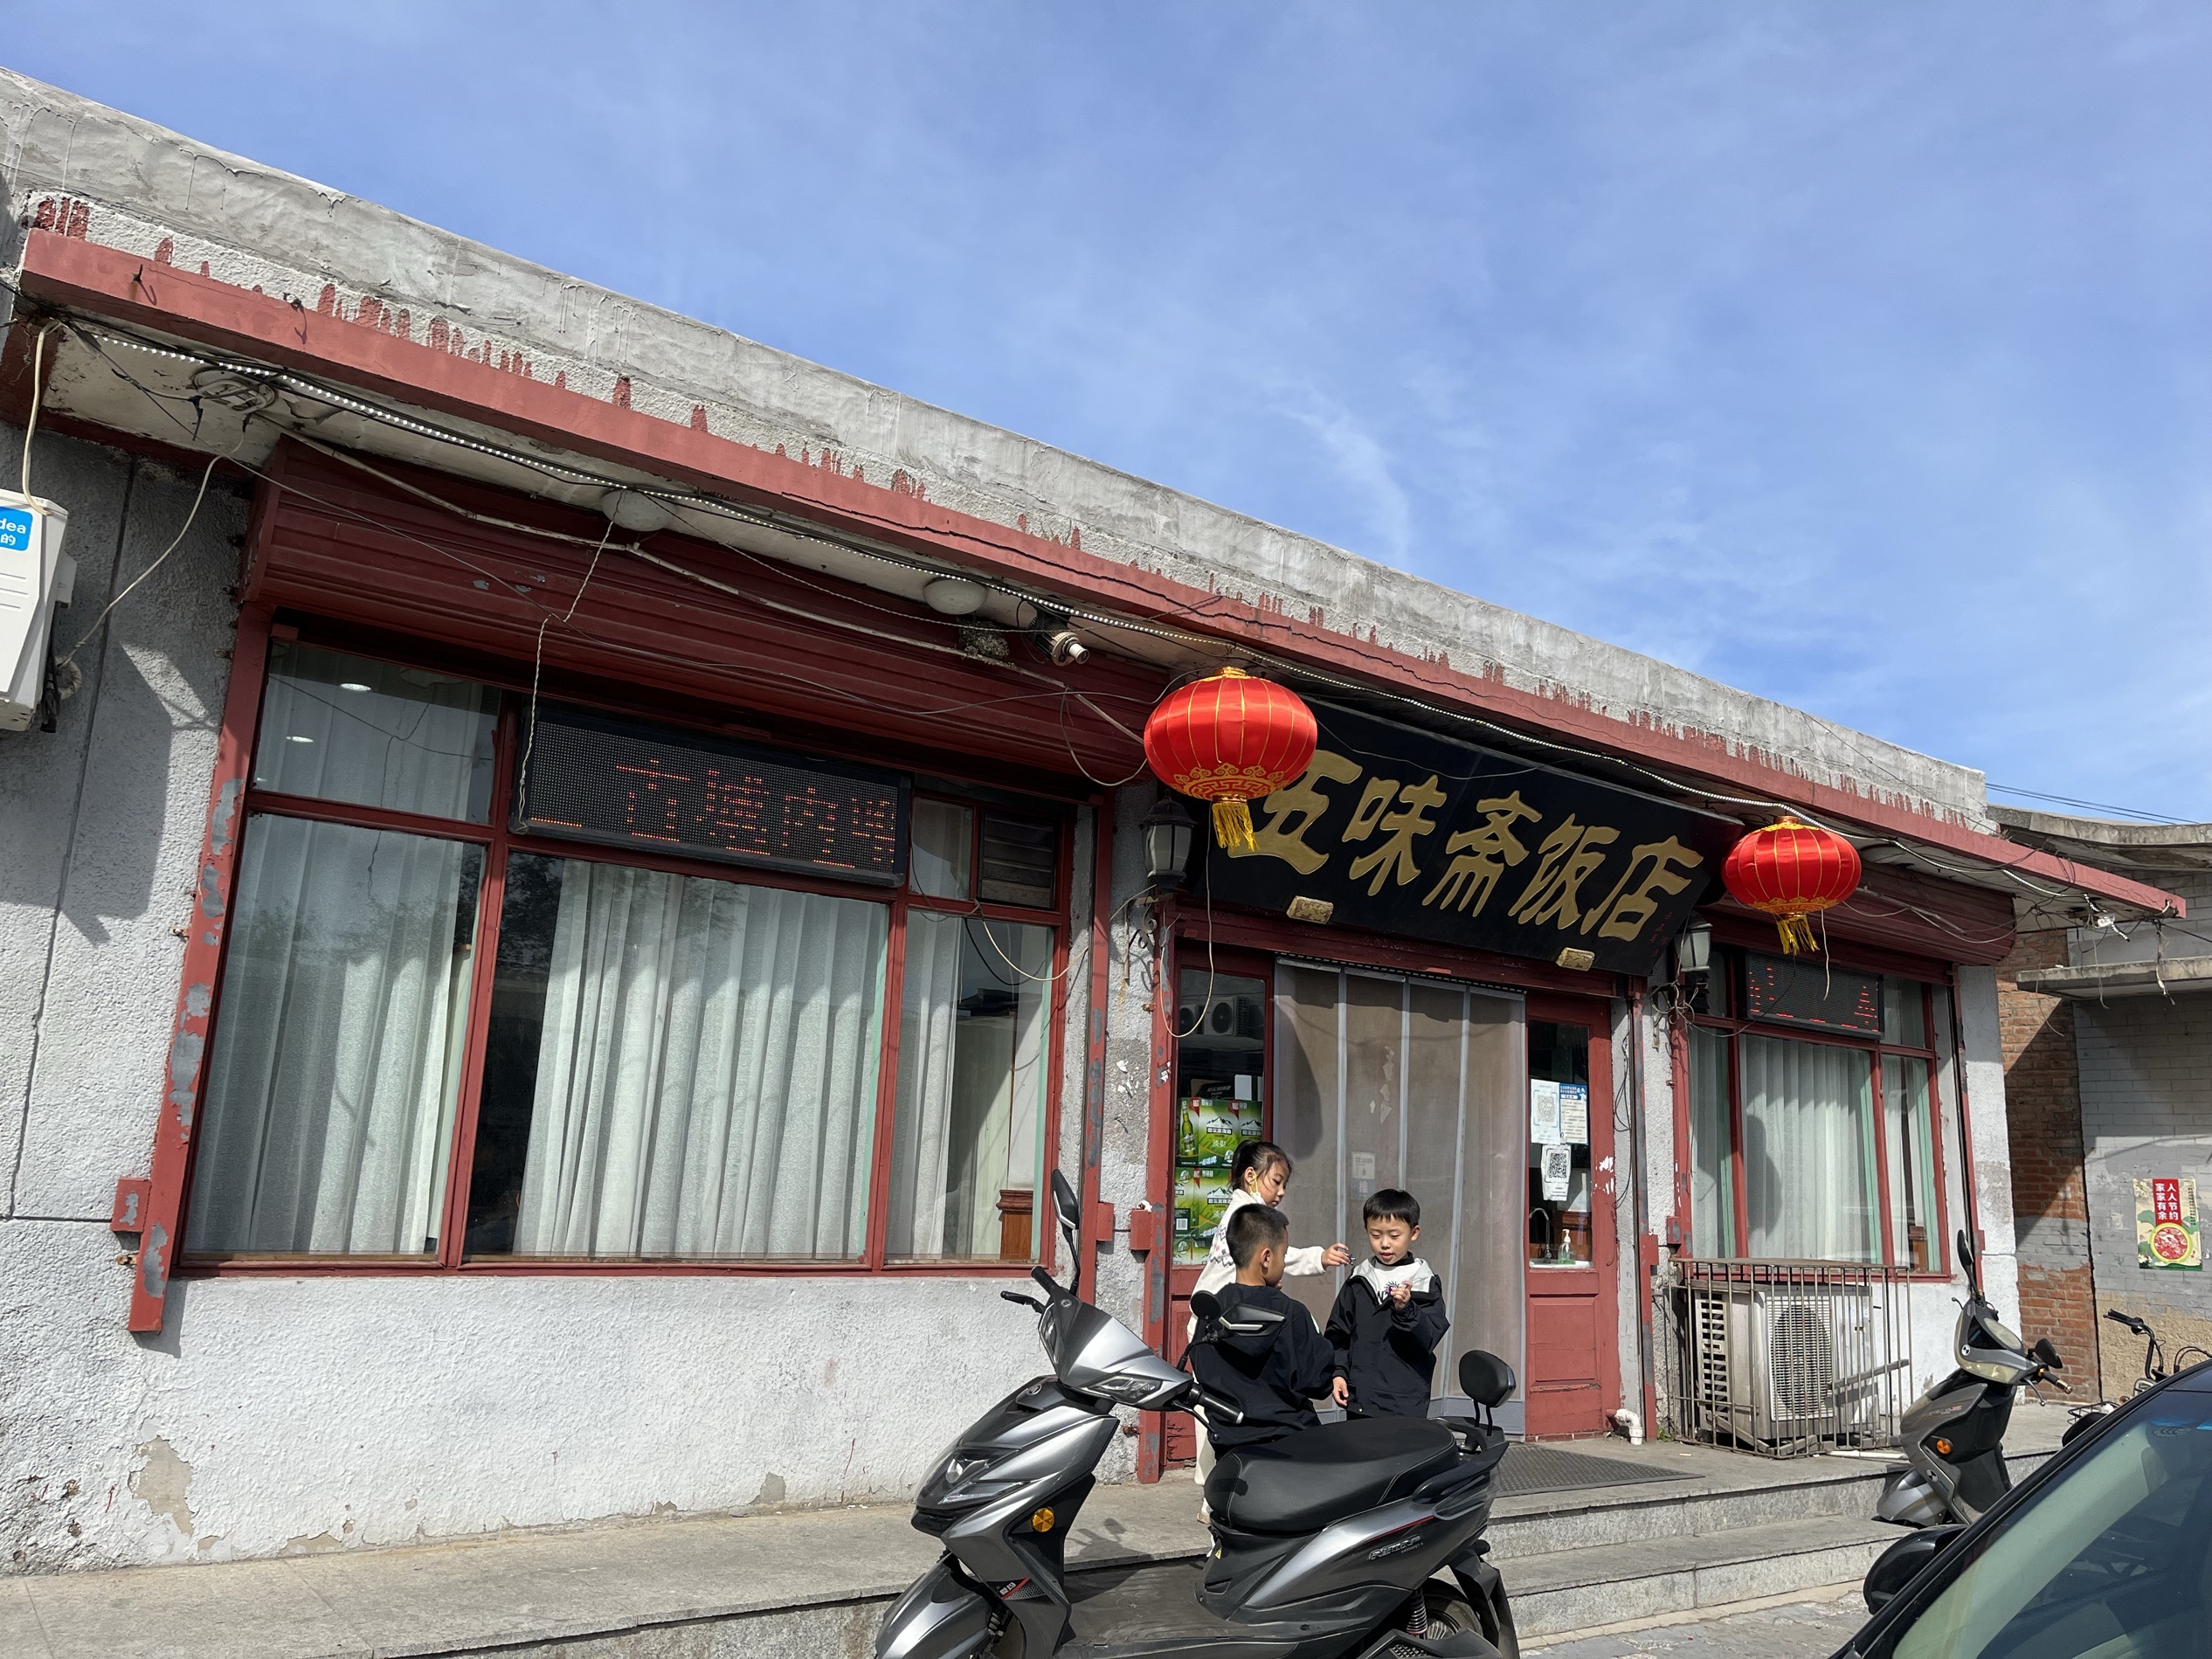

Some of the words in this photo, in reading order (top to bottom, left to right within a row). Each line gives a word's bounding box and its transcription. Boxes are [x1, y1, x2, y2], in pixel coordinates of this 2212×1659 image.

[1227, 749, 1704, 942] 五味斋饭店
[2155, 1183, 2167, 1220] 家家有余
[2167, 1183, 2179, 1220] 人人节约
